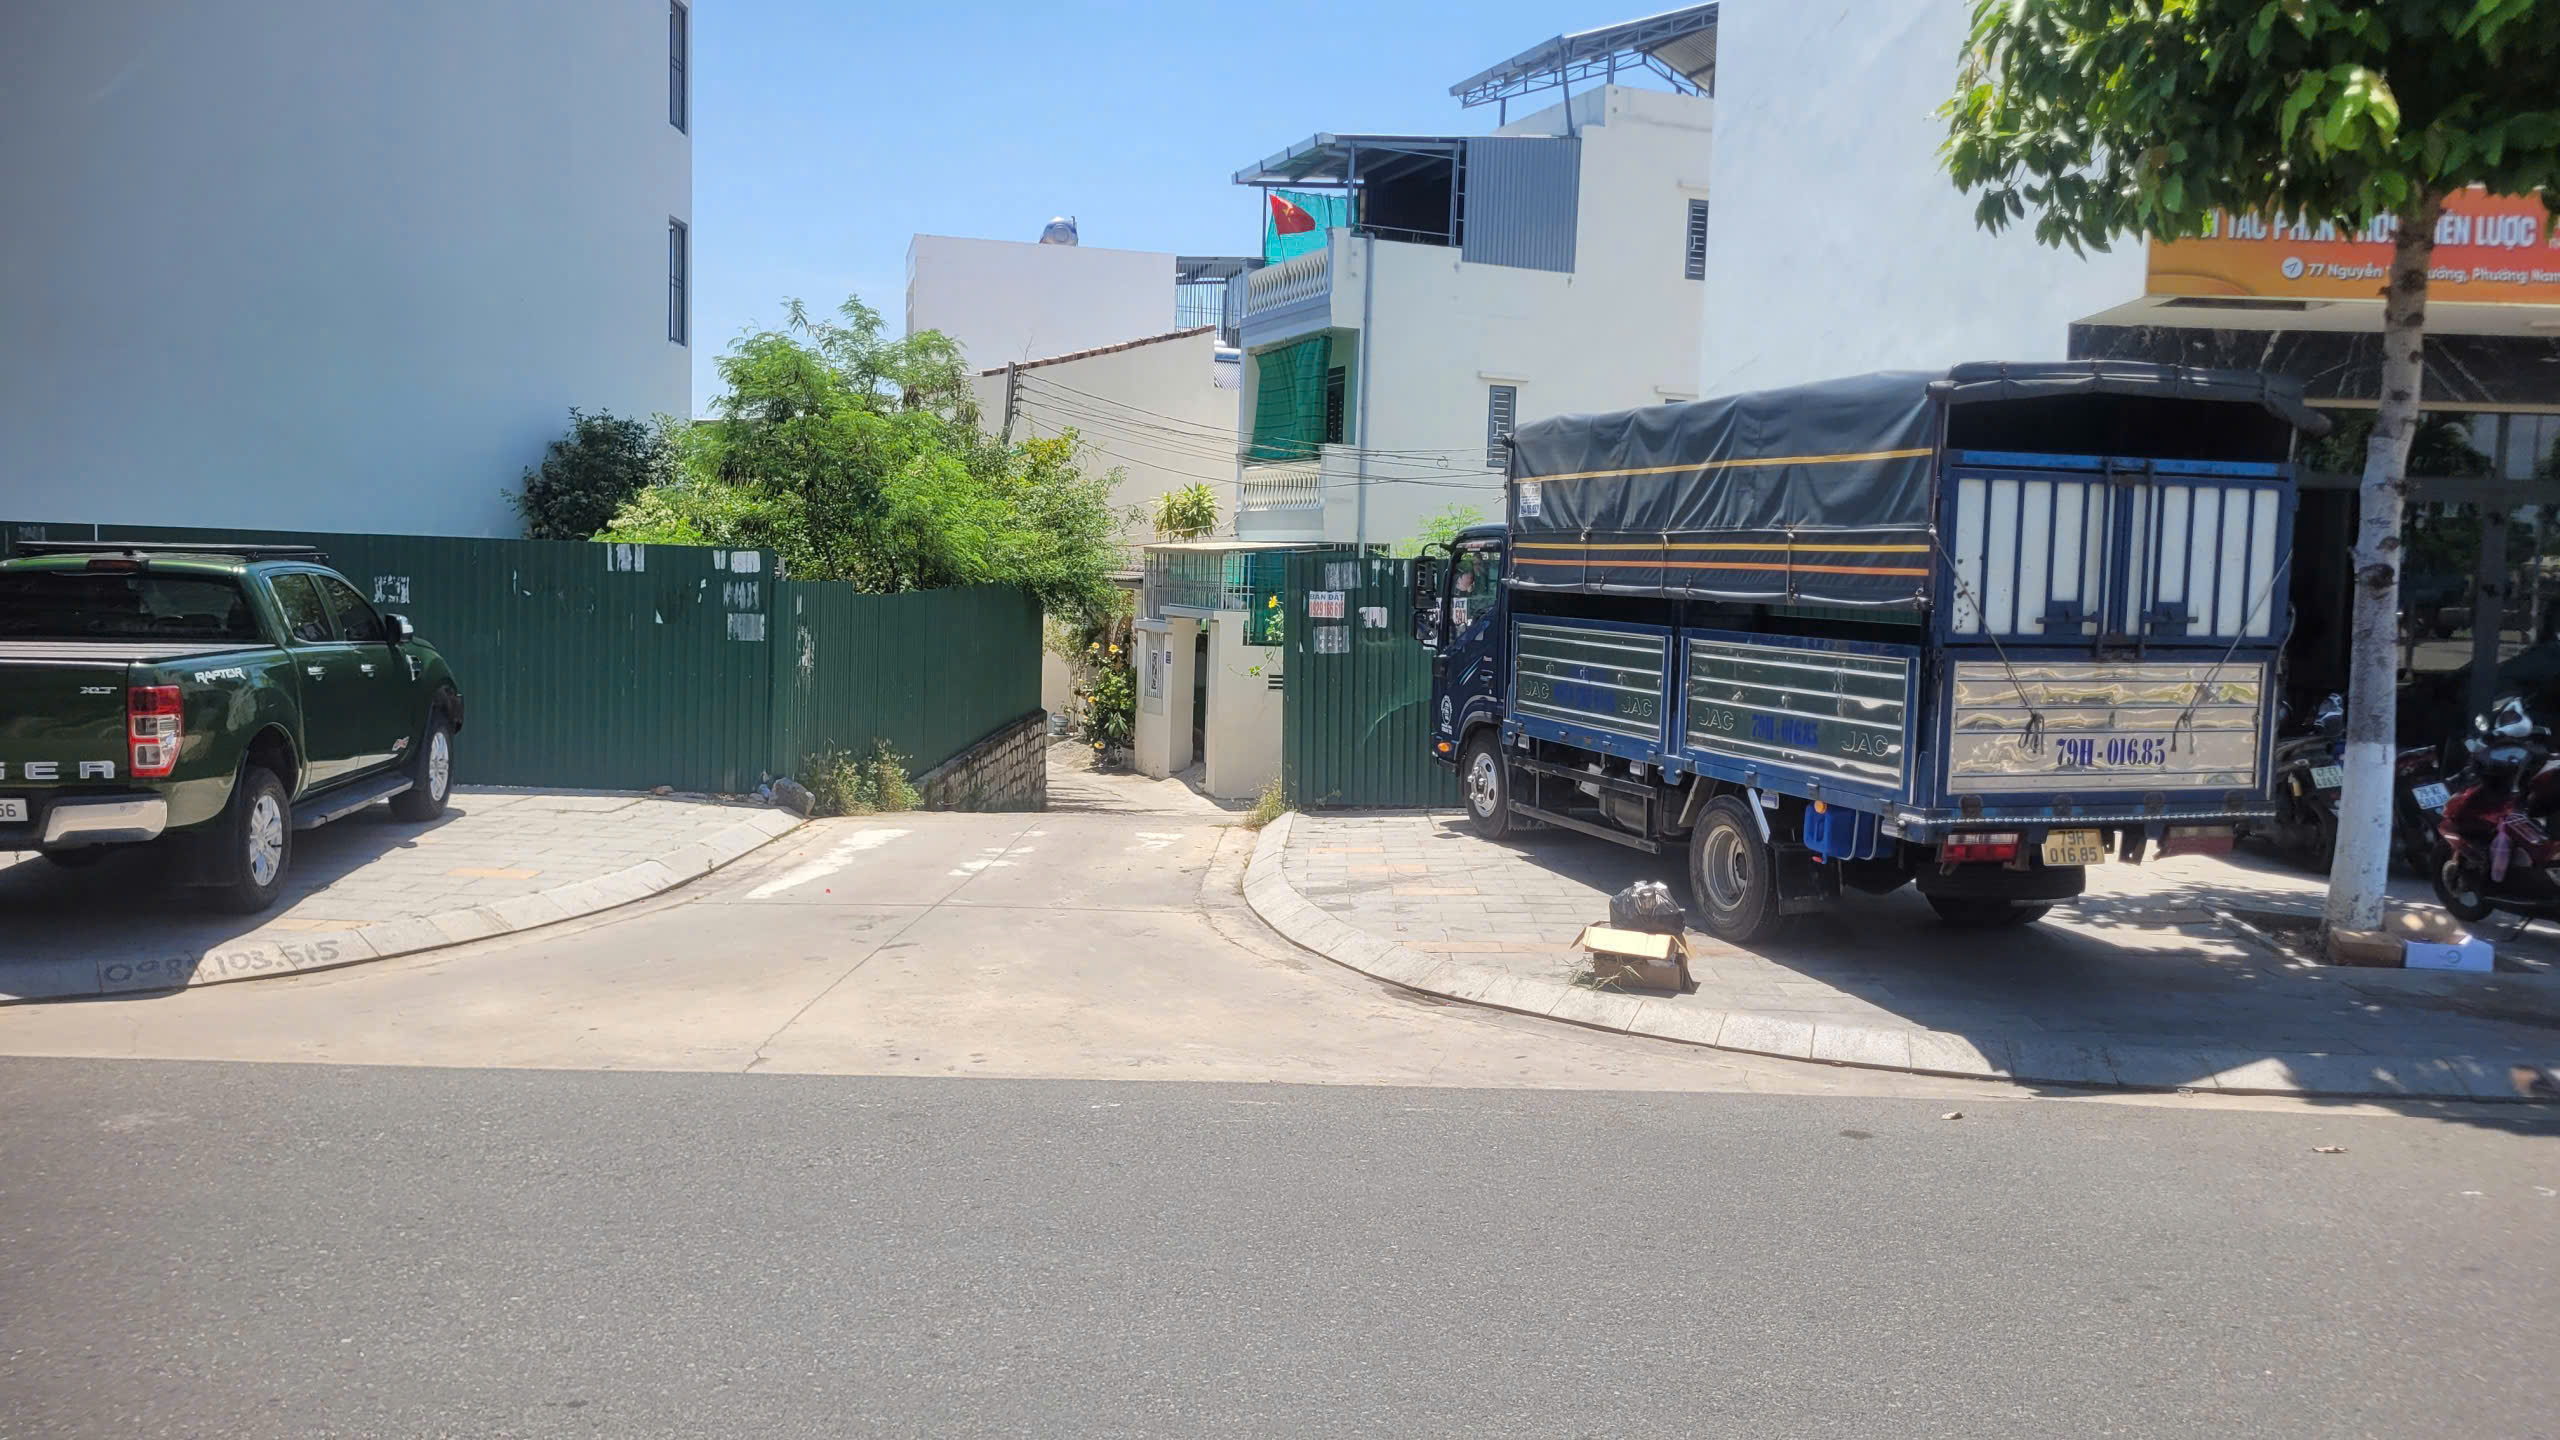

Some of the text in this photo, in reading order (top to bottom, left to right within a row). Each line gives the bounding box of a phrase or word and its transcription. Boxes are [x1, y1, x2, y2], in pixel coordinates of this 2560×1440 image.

[2474, 212, 2537, 252] LƯỢC
[2308, 264, 2324, 276] 77
[195, 667, 246, 684] RAPTOR
[1526, 681, 1550, 699] JAC
[1621, 696, 1653, 717] JAC
[1699, 707, 1734, 731] JAC
[1841, 731, 1889, 757] JAC
[2061, 831, 2085, 845] 79H
